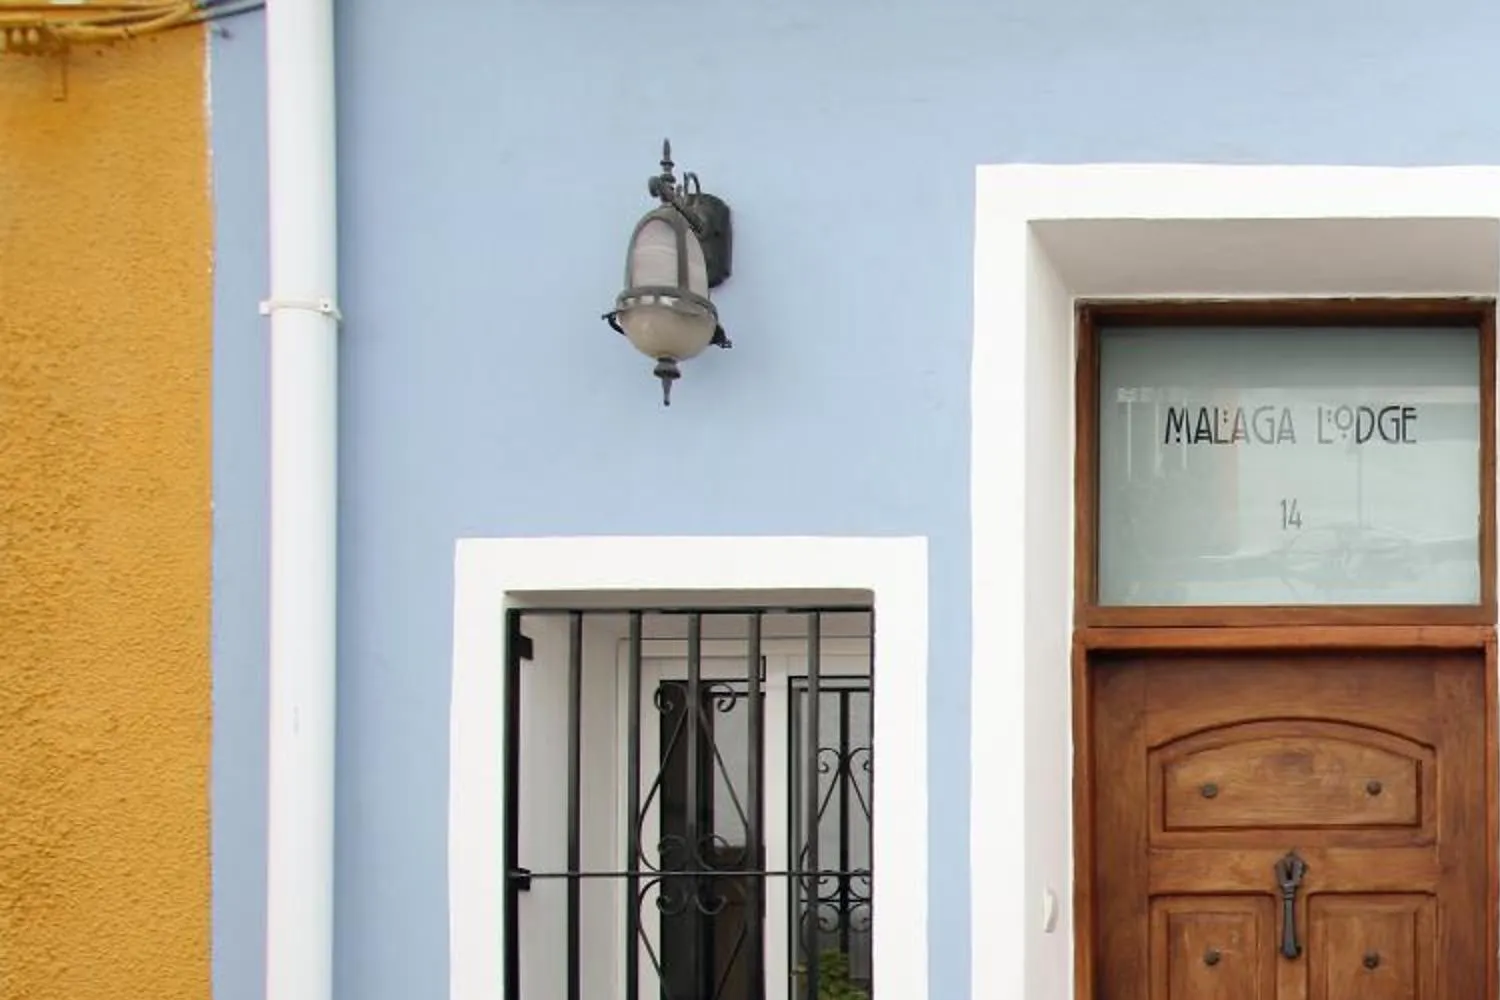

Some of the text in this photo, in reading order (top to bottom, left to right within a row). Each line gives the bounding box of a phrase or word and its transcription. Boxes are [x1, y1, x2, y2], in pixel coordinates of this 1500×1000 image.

[1164, 405, 1417, 445] MALAGA LODGE
[1280, 499, 1302, 530] 14
